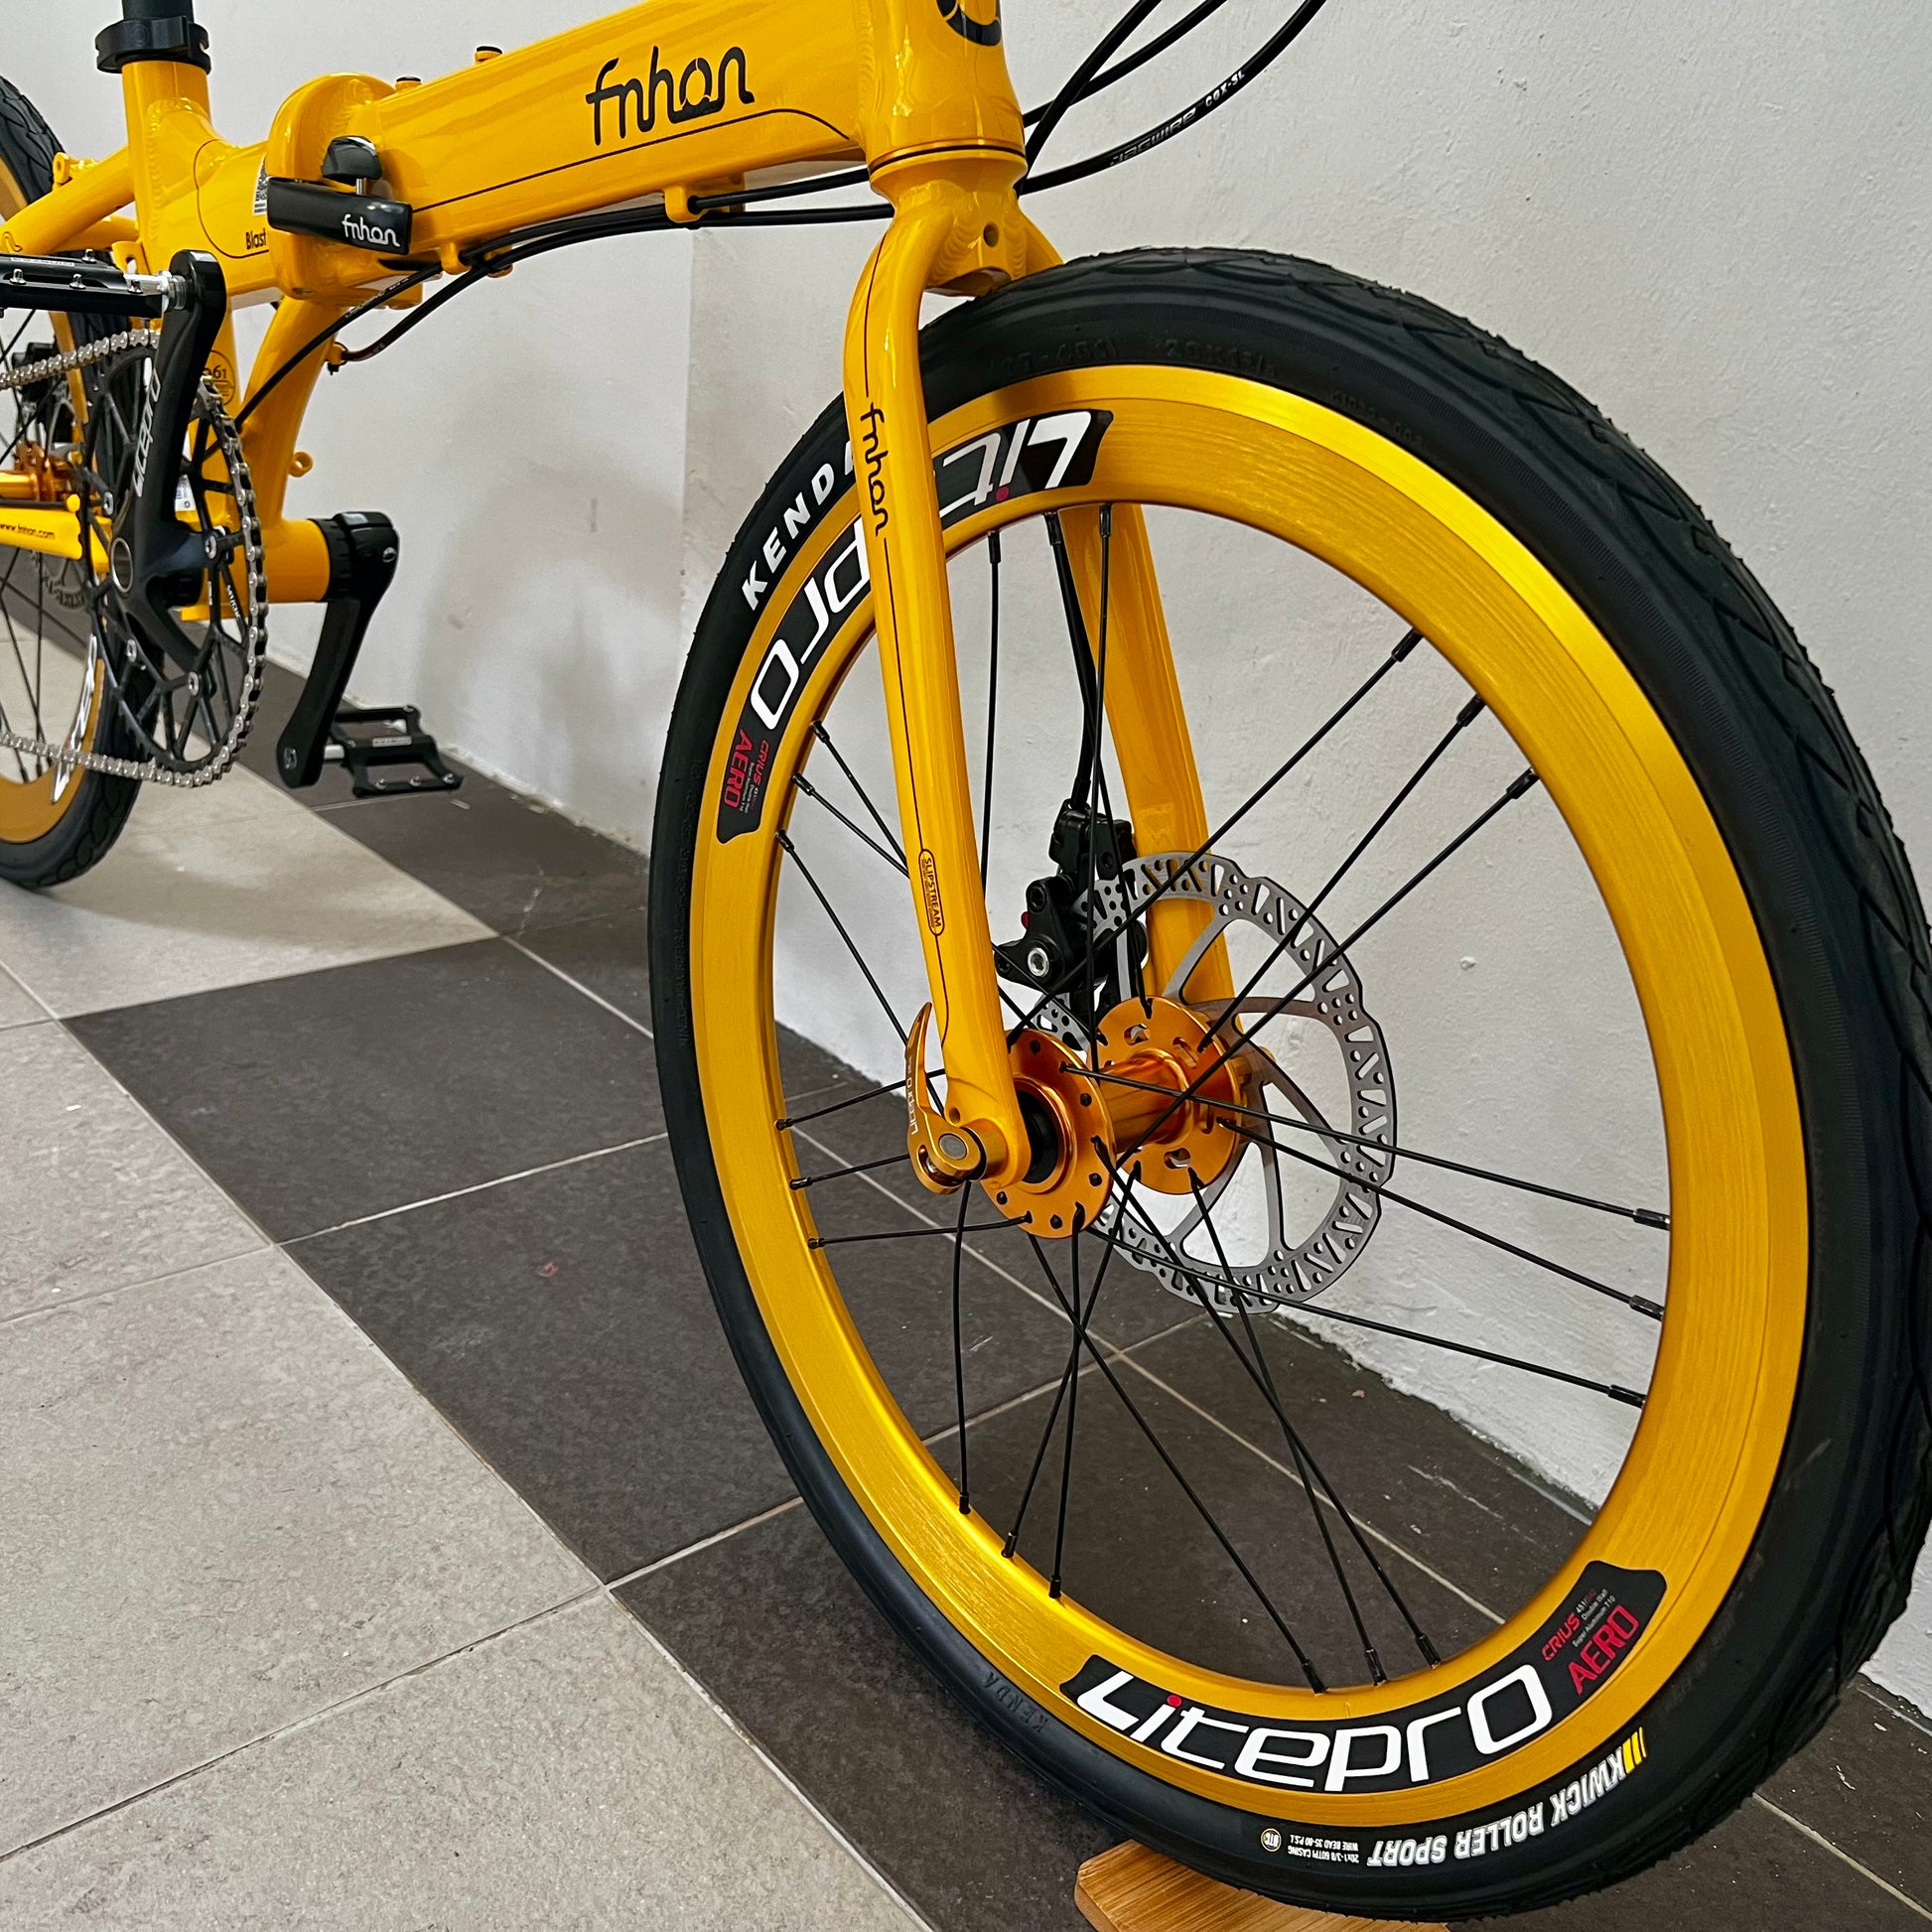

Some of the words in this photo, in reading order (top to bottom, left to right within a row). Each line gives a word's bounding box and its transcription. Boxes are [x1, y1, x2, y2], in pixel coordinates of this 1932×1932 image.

[586, 45, 756, 146] fnhon
[245, 227, 268, 249] Blast
[342, 213, 401, 247] fnhon
[860, 401, 889, 537] fnhon
[751, 410, 1092, 730] Litpro
[724, 729, 753, 808] AERO
[924, 857, 942, 927] SLIPSTREAM
[1541, 1612, 1581, 1661] CRIUS
[1568, 1604, 1640, 1695] AERO
[1076, 1664, 1553, 1792] Litepro
[1550, 1745, 1626, 1828] KWICK
[1287, 1845, 1311, 1859] CASING
[1323, 1839, 1341, 1850] BEAD
[1341, 1841, 1359, 1852] WIRE
[1366, 1835, 1448, 1866] SPORT
[1453, 1801, 1545, 1860] ROLLER
